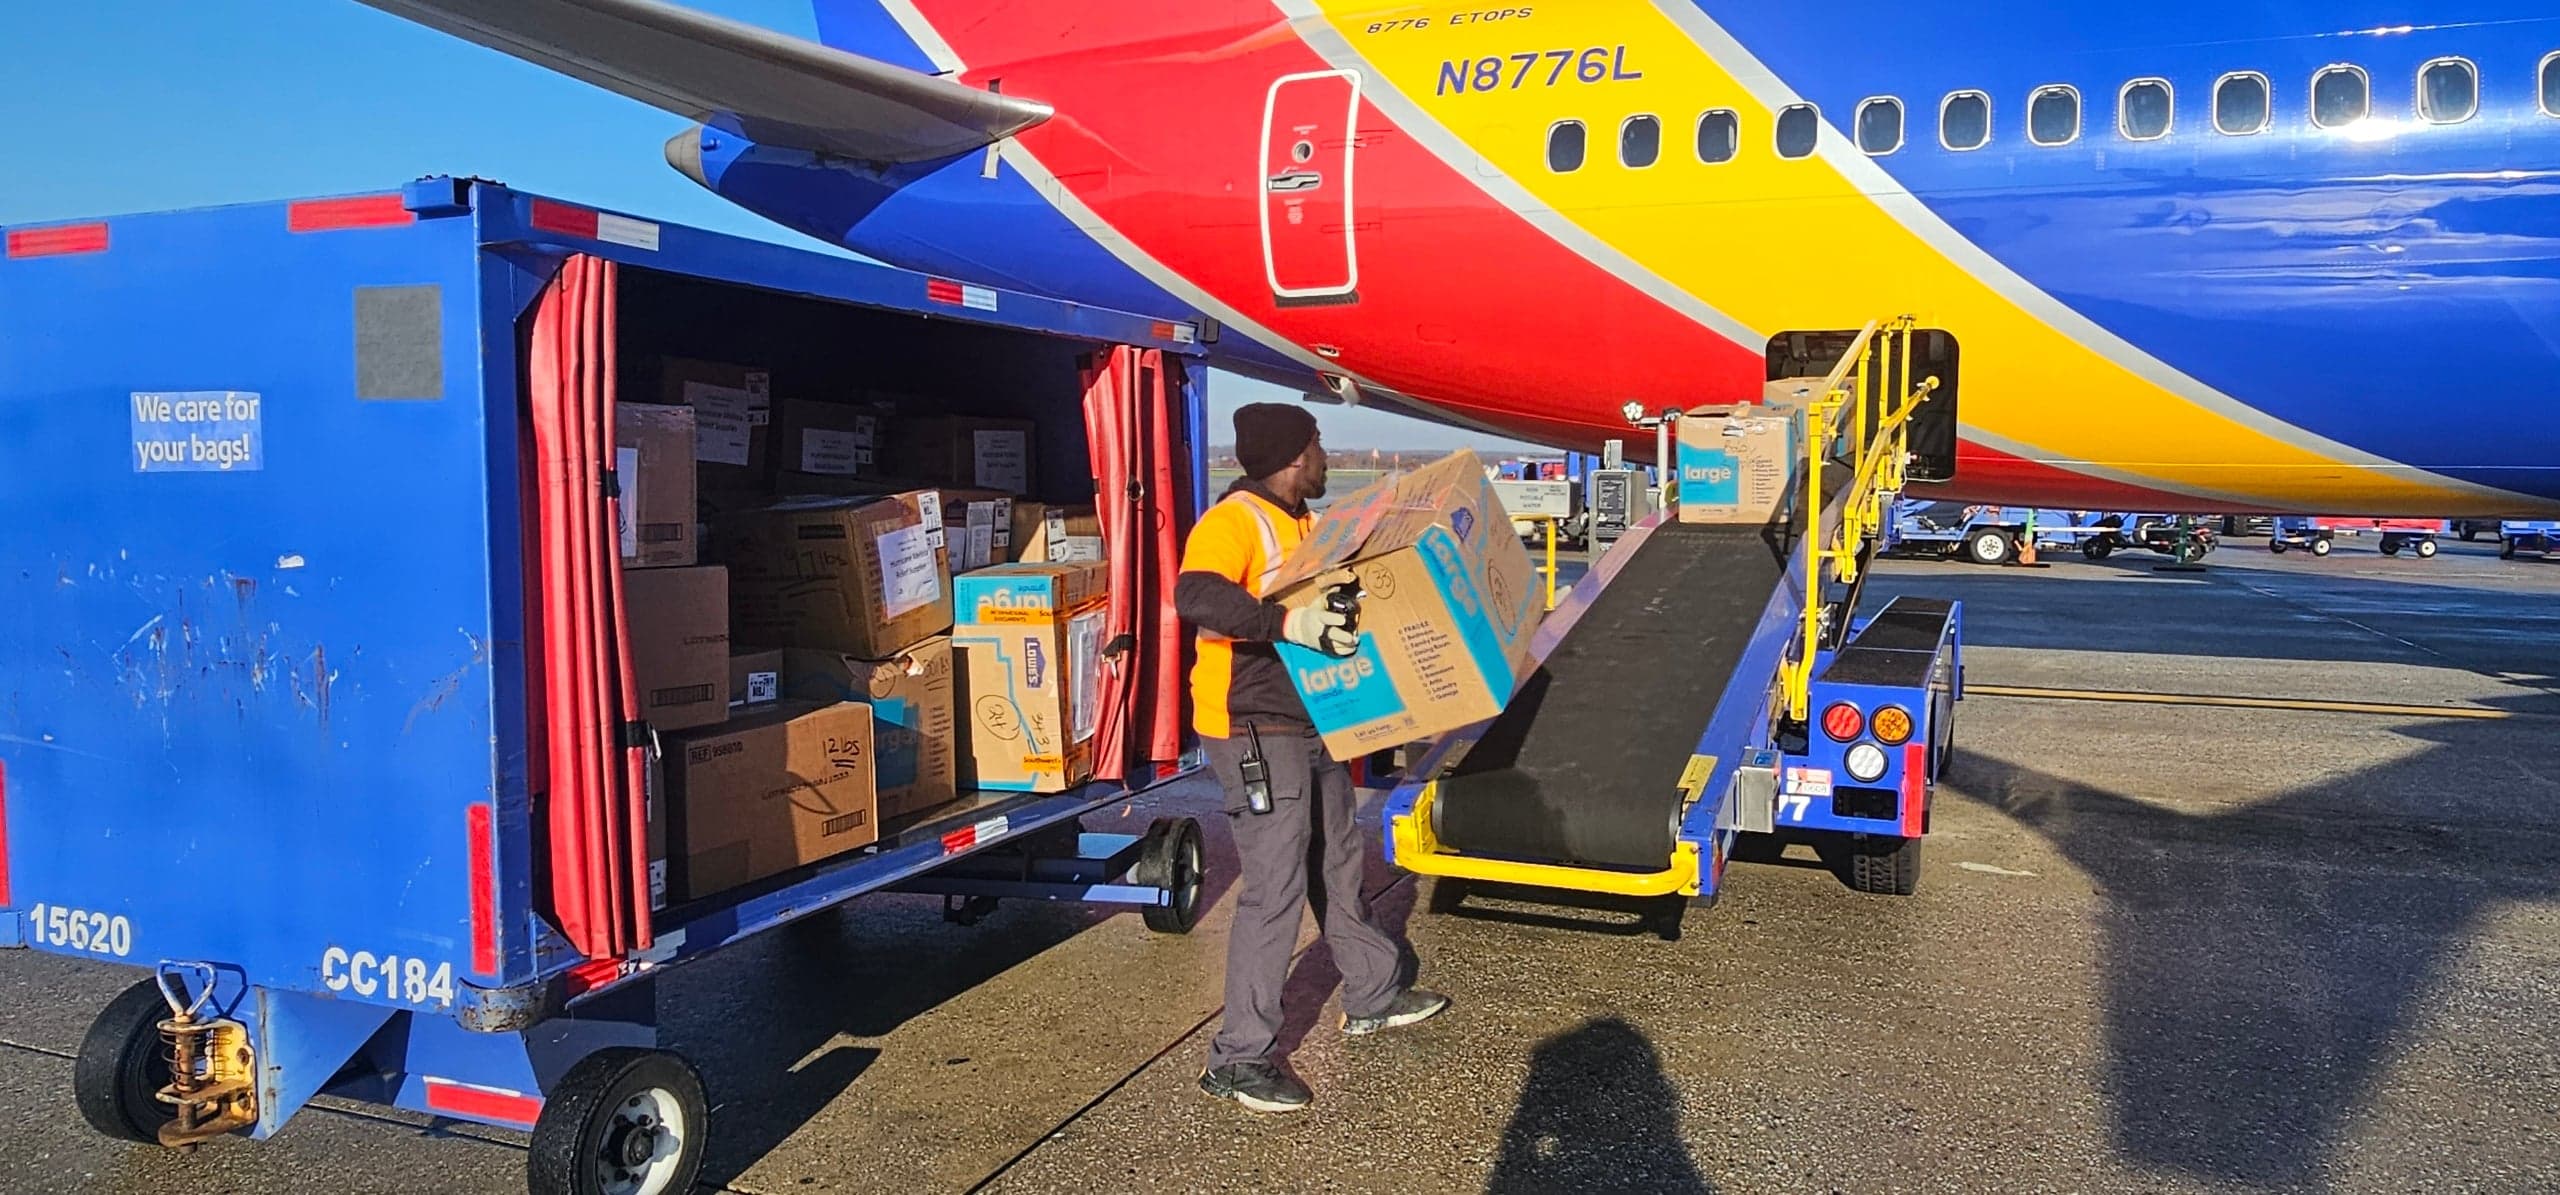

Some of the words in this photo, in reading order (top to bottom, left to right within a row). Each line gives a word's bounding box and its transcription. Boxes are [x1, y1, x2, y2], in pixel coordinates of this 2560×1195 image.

[1367, 18, 1430, 34] 8776
[1450, 7, 1533, 26] ETOPS
[1436, 45, 1643, 97] N8776L
[135, 394, 171, 422] We
[174, 399, 221, 422] care
[224, 391, 259, 421] for
[136, 440, 187, 470] your
[190, 432, 250, 469] bags!
[1684, 464, 1732, 484] large
[1297, 656, 1374, 695] large
[690, 746, 710, 762] REF
[29, 903, 131, 957] 15620
[321, 946, 453, 1008] CC184
